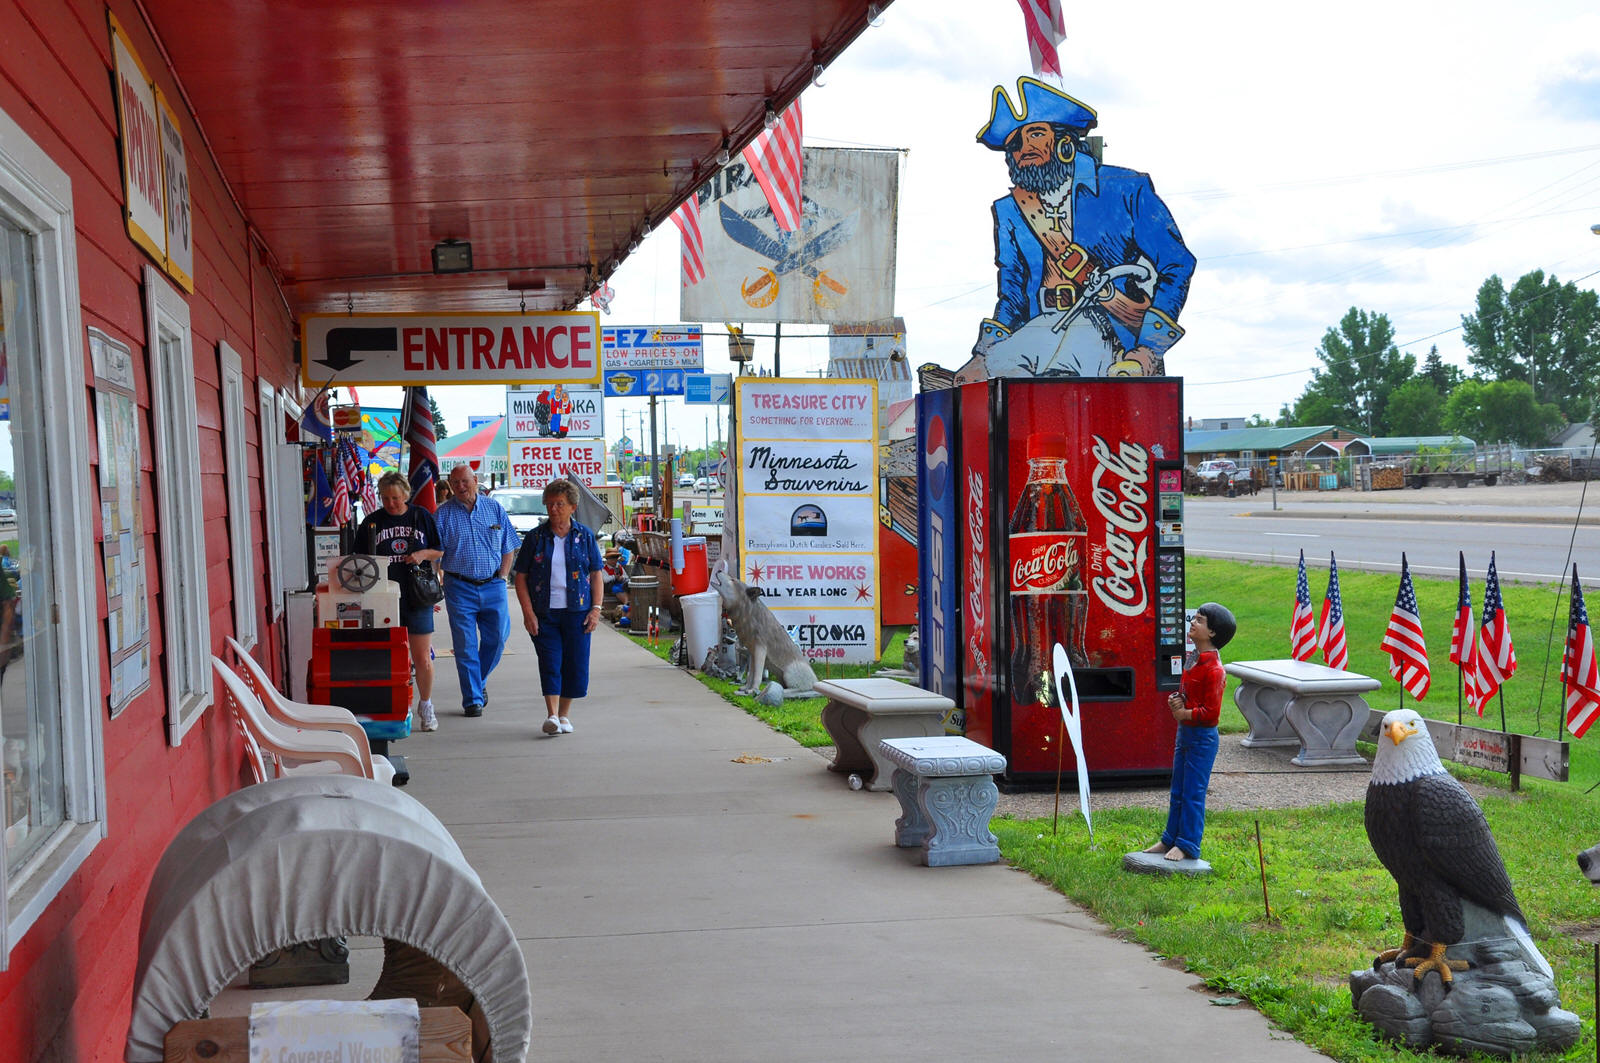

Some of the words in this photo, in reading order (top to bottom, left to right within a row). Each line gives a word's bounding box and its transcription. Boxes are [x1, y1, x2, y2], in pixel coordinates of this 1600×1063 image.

[616, 329, 648, 347] EZ
[402, 326, 592, 371] ENTRANCE
[606, 348, 628, 358] LOW
[635, 348, 676, 358] PRICES
[683, 347, 698, 357] ON
[606, 359, 621, 367] GAS
[629, 359, 674, 367] CIGARETTES
[681, 358, 698, 366] MILK
[513, 400, 596, 415] MINKA
[752, 393, 828, 410] TREASURE
[831, 395, 867, 410] CITY
[515, 419, 591, 432] MOINS
[750, 416, 797, 425] SOMETHING
[800, 416, 814, 425] FOR
[522, 446, 562, 460] FREE
[568, 448, 593, 460] ICE
[749, 446, 857, 470] Minnesota
[513, 463, 553, 477] FRESH
[558, 462, 602, 475] WATER
[522, 478, 549, 488] REST
[764, 468, 869, 491] Souvenirs
[691, 510, 706, 518] Come
[1092, 434, 1149, 617] Coca-Cola
[375, 526, 425, 546] UNIVERSTY
[969, 465, 985, 631] Coca-Cola
[1013, 537, 1079, 587] Coca-Cola
[766, 565, 804, 580] FIRE
[808, 565, 867, 580] WORKS
[760, 588, 781, 597] ALL
[786, 588, 817, 597] YEAR
[821, 588, 848, 597] LONG
[931, 510, 945, 697] PEPSI
[790, 625, 865, 648] ETONKA
